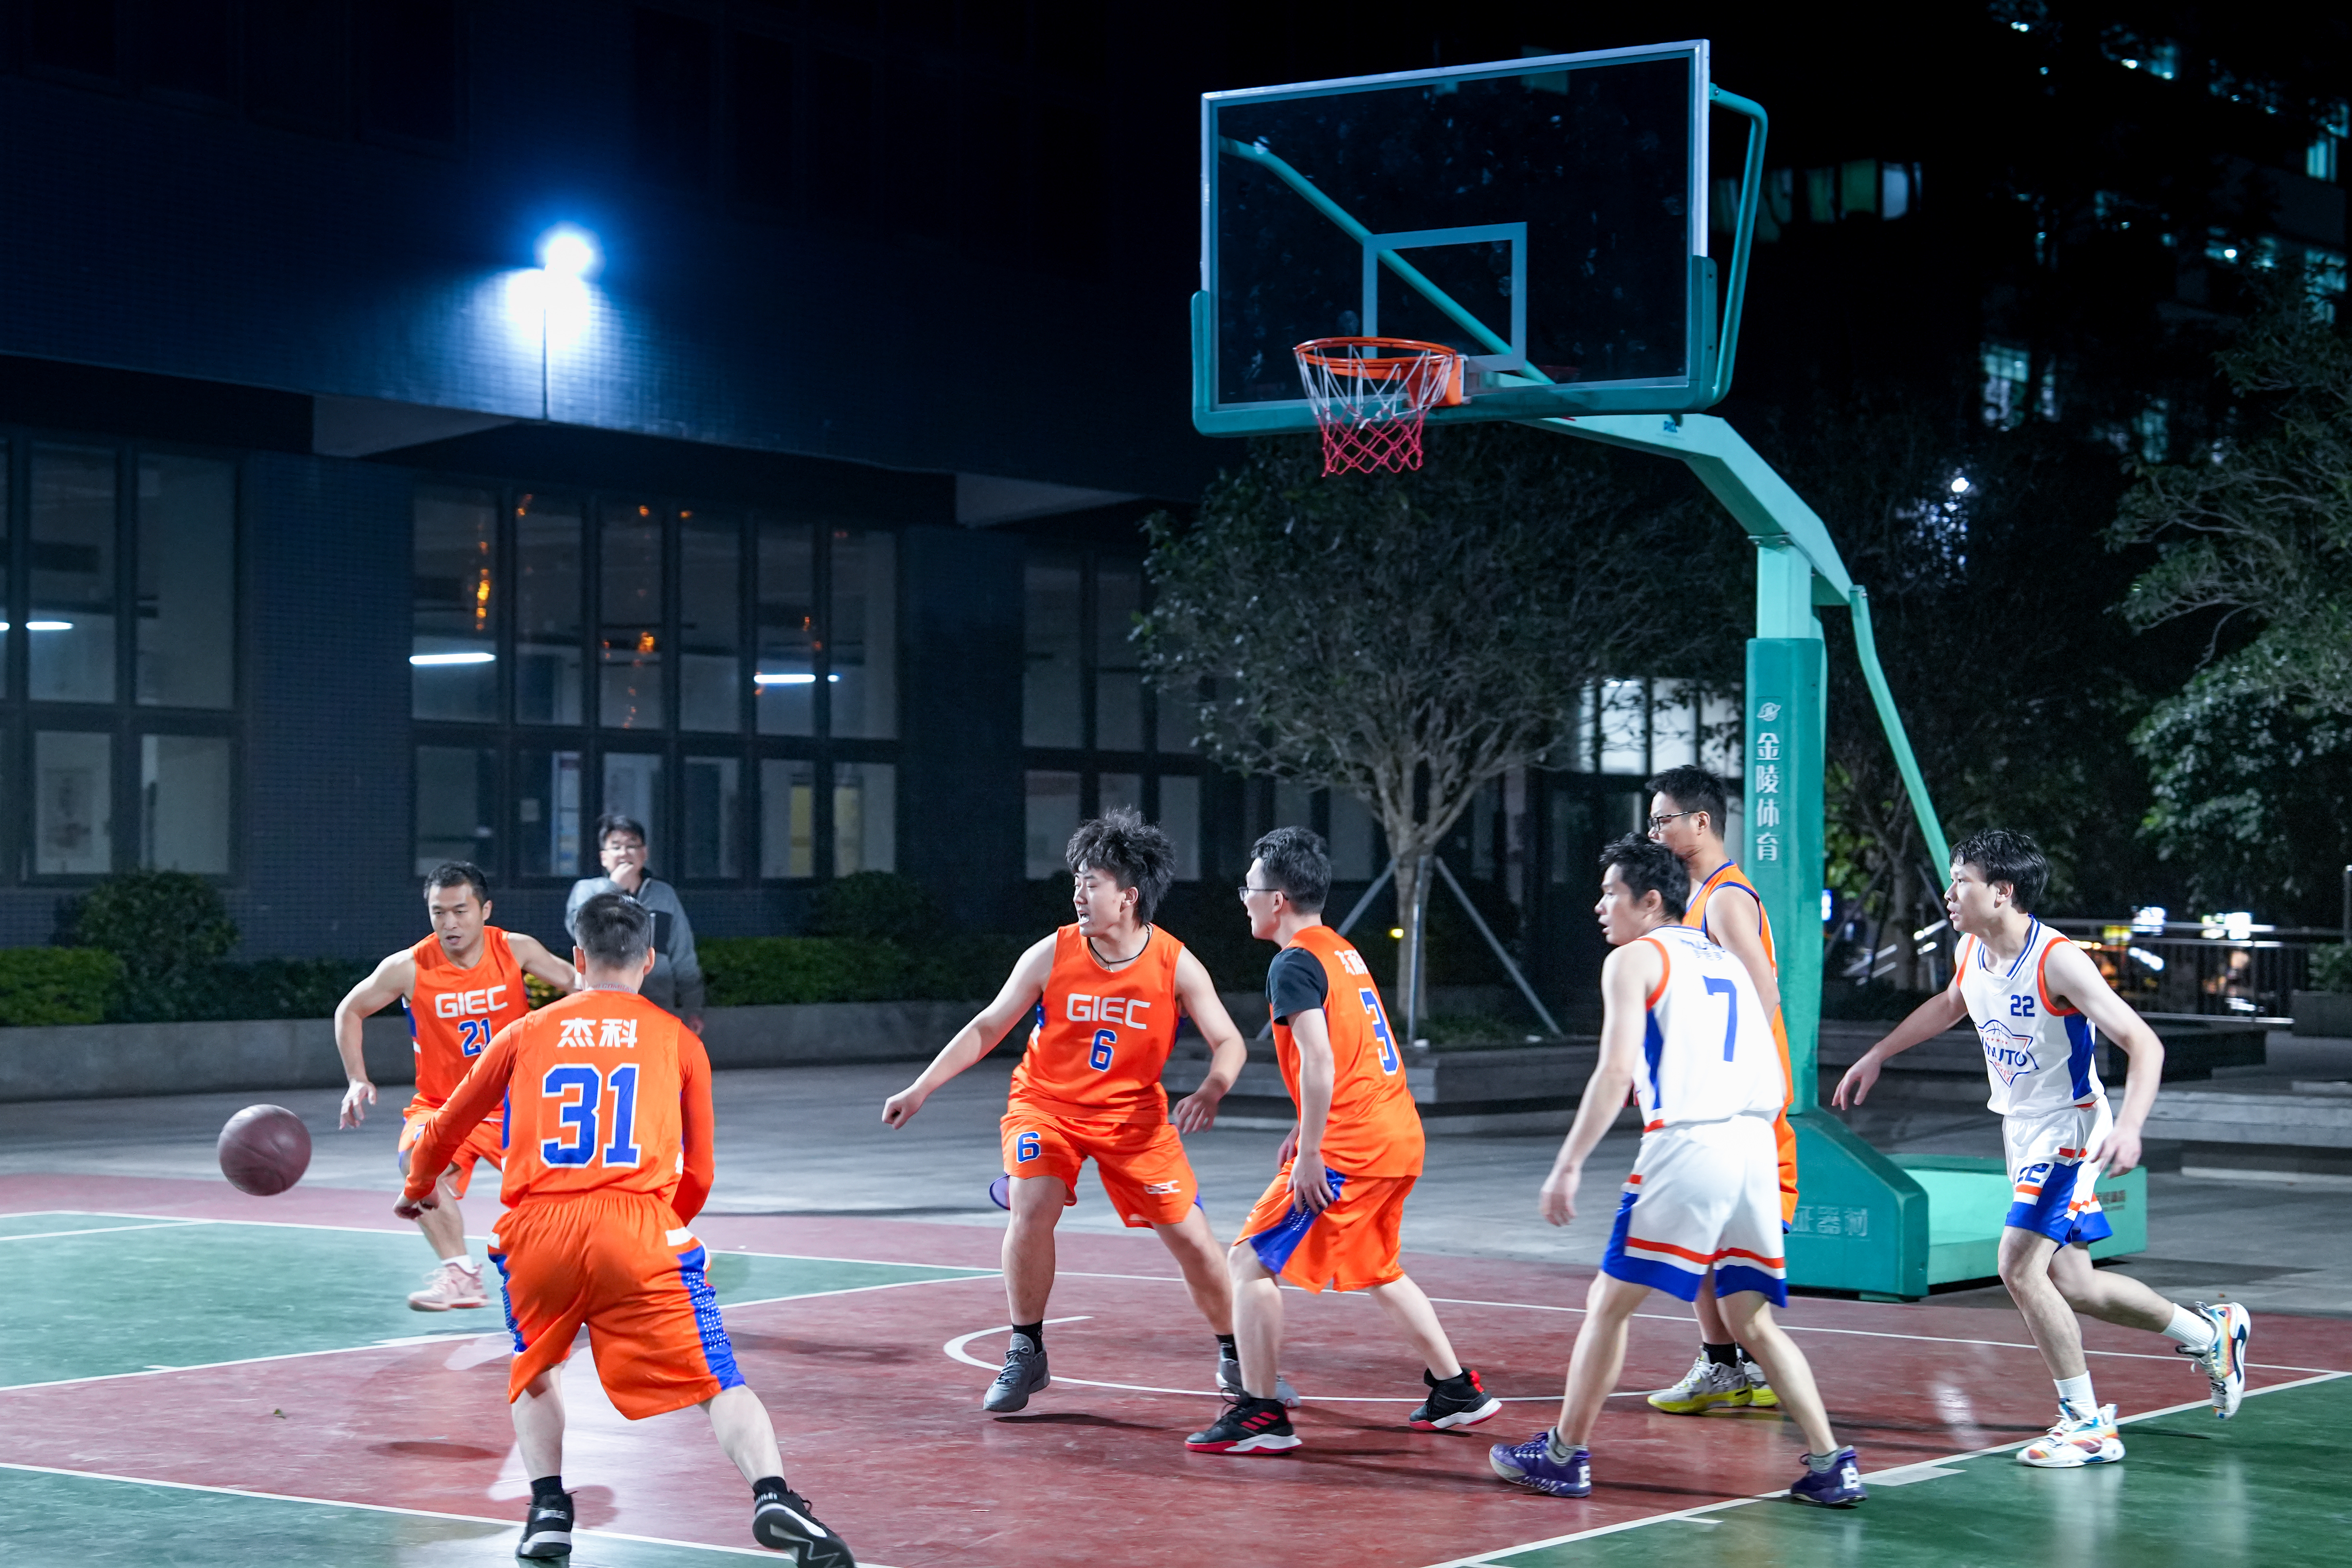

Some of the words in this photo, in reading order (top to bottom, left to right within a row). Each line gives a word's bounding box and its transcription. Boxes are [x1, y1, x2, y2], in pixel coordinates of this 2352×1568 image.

[1756, 732, 1780, 861] 金陵体育
[435, 985, 508, 1019] GIEC
[1066, 993, 1151, 1029] GIEC
[1702, 975, 1737, 1062] 7
[2010, 995, 2035, 1017] 22
[458, 1018, 492, 1058] 21
[557, 1017, 638, 1048] 杰科
[1088, 1028, 1118, 1072] 6
[540, 1062, 641, 1169] 31
[1016, 1131, 1041, 1163] 6
